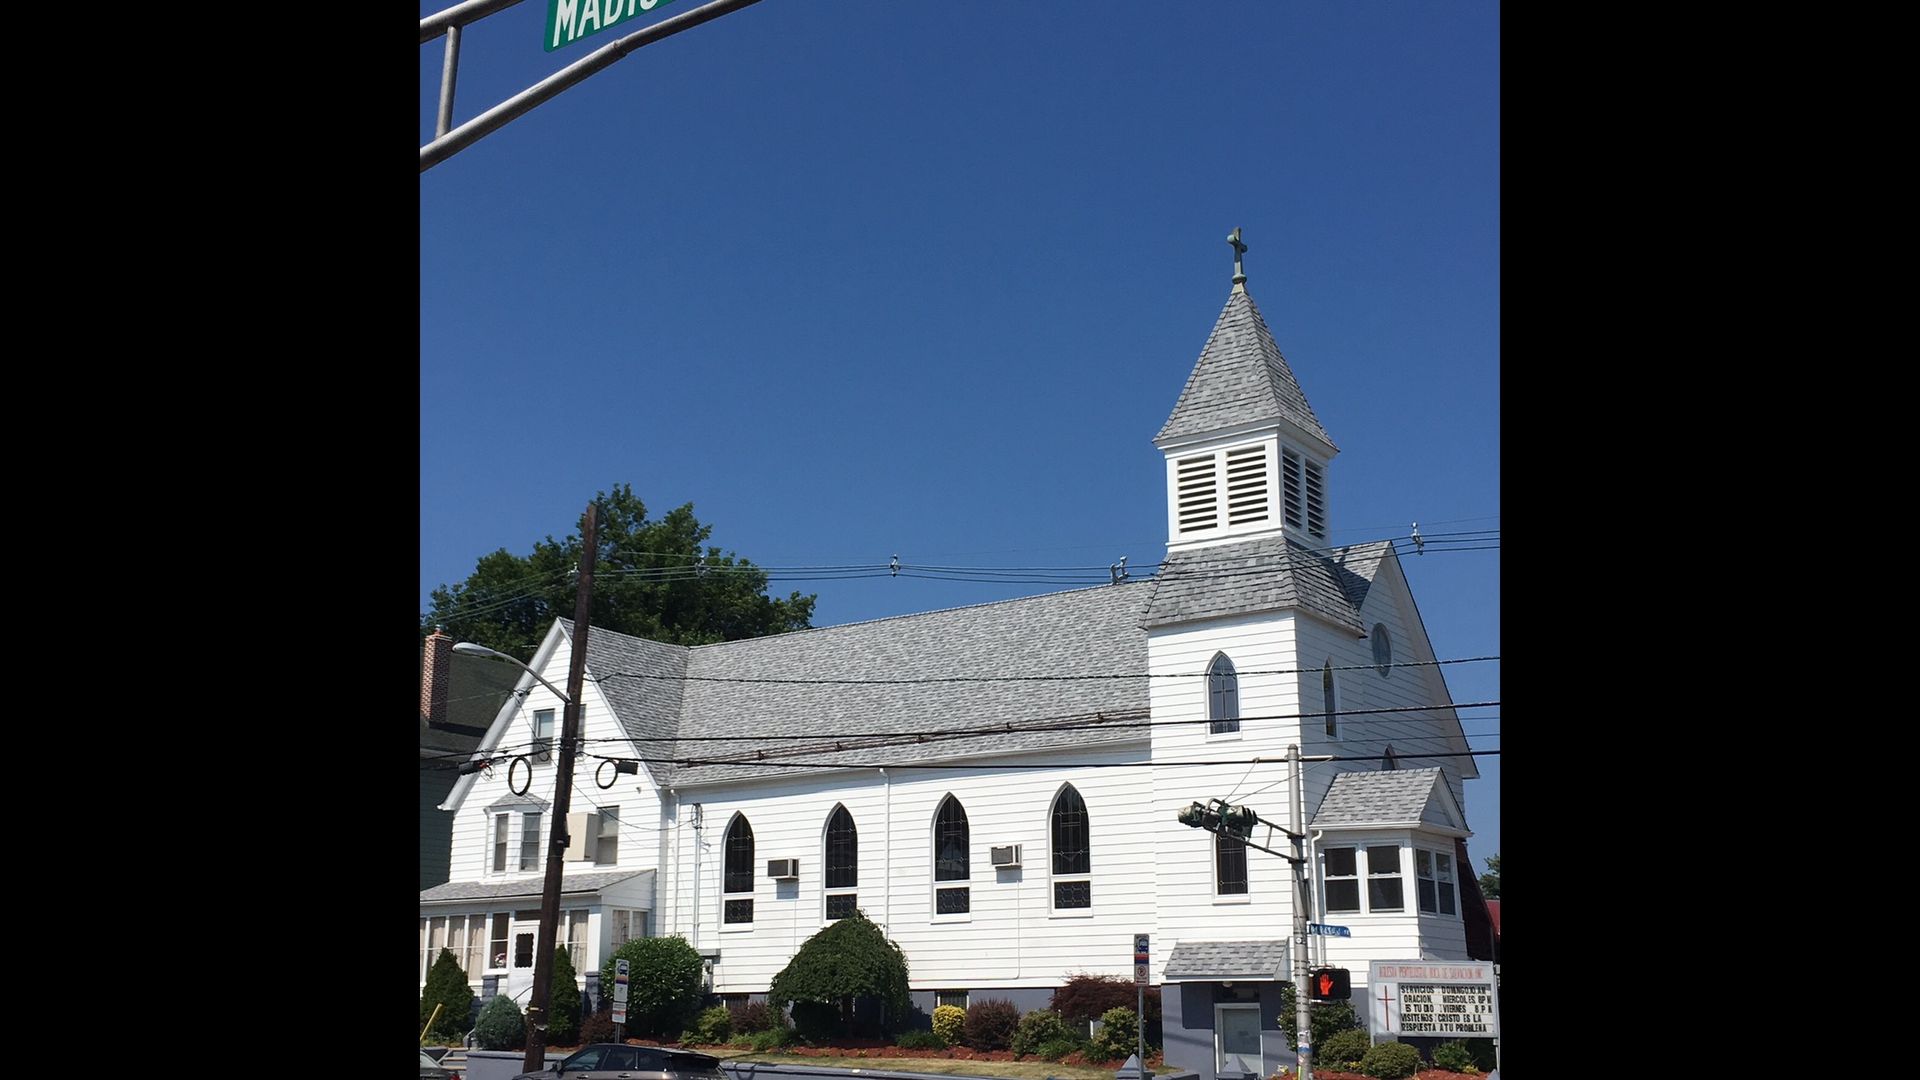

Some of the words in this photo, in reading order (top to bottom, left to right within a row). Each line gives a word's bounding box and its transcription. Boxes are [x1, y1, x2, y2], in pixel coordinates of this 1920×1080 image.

[553, 0, 659, 48] MAD
[1401, 985, 1435, 994] SERVICIOS
[1438, 1014, 1461, 1022] CRISTO
[1401, 1023, 1437, 1032] RESPUESTA
